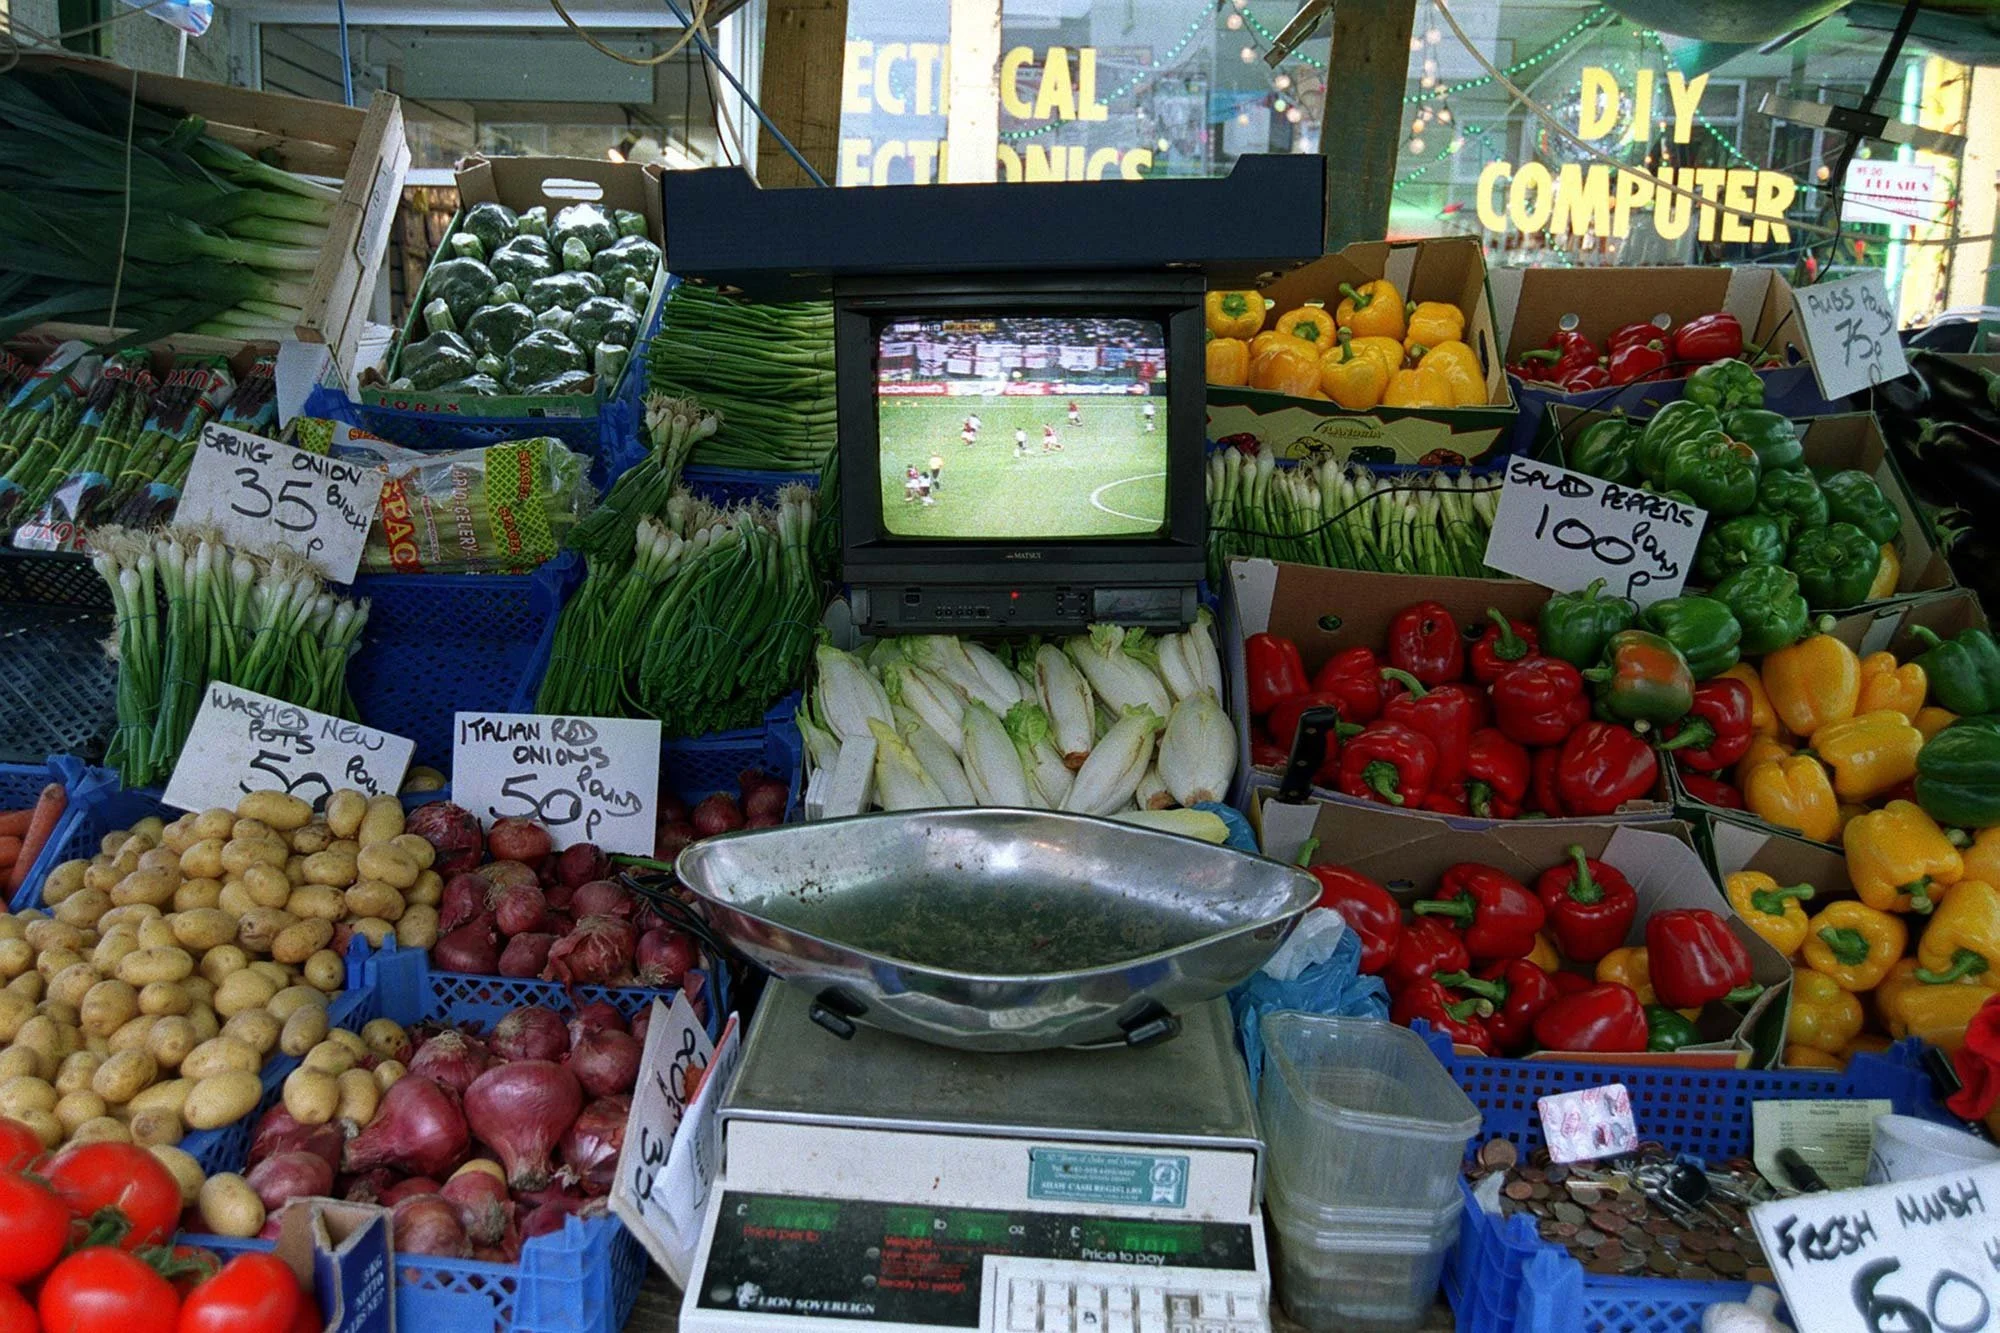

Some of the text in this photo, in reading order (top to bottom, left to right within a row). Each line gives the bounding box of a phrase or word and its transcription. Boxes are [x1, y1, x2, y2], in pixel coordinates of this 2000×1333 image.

[1578, 67, 1709, 144] DIY
[1477, 162, 1796, 244] COMPUTER
[203, 426, 362, 487] SPRING ONION
[231, 467, 318, 532] 35
[381, 478, 420, 566] SPAC
[1600, 484, 1696, 527] PEPPERS
[1535, 503, 1636, 565] 100
[212, 688, 384, 751] WASHED NEW
[249, 719, 316, 755] POTS
[461, 717, 598, 746] ITALIAN RED
[513, 746, 610, 769] ONIONS
[489, 773, 582, 825] 50
[933, 1218, 948, 1231] lb
[1008, 1225, 1025, 1236] oz
[1070, 1226, 1080, 1239] £
[1773, 1177, 1986, 1270] FRESH MUSH
[1082, 1248, 1165, 1267] Price to pay
[757, 1297, 876, 1315] LION SOVEREIGN
[1851, 1256, 1991, 1333] 60
